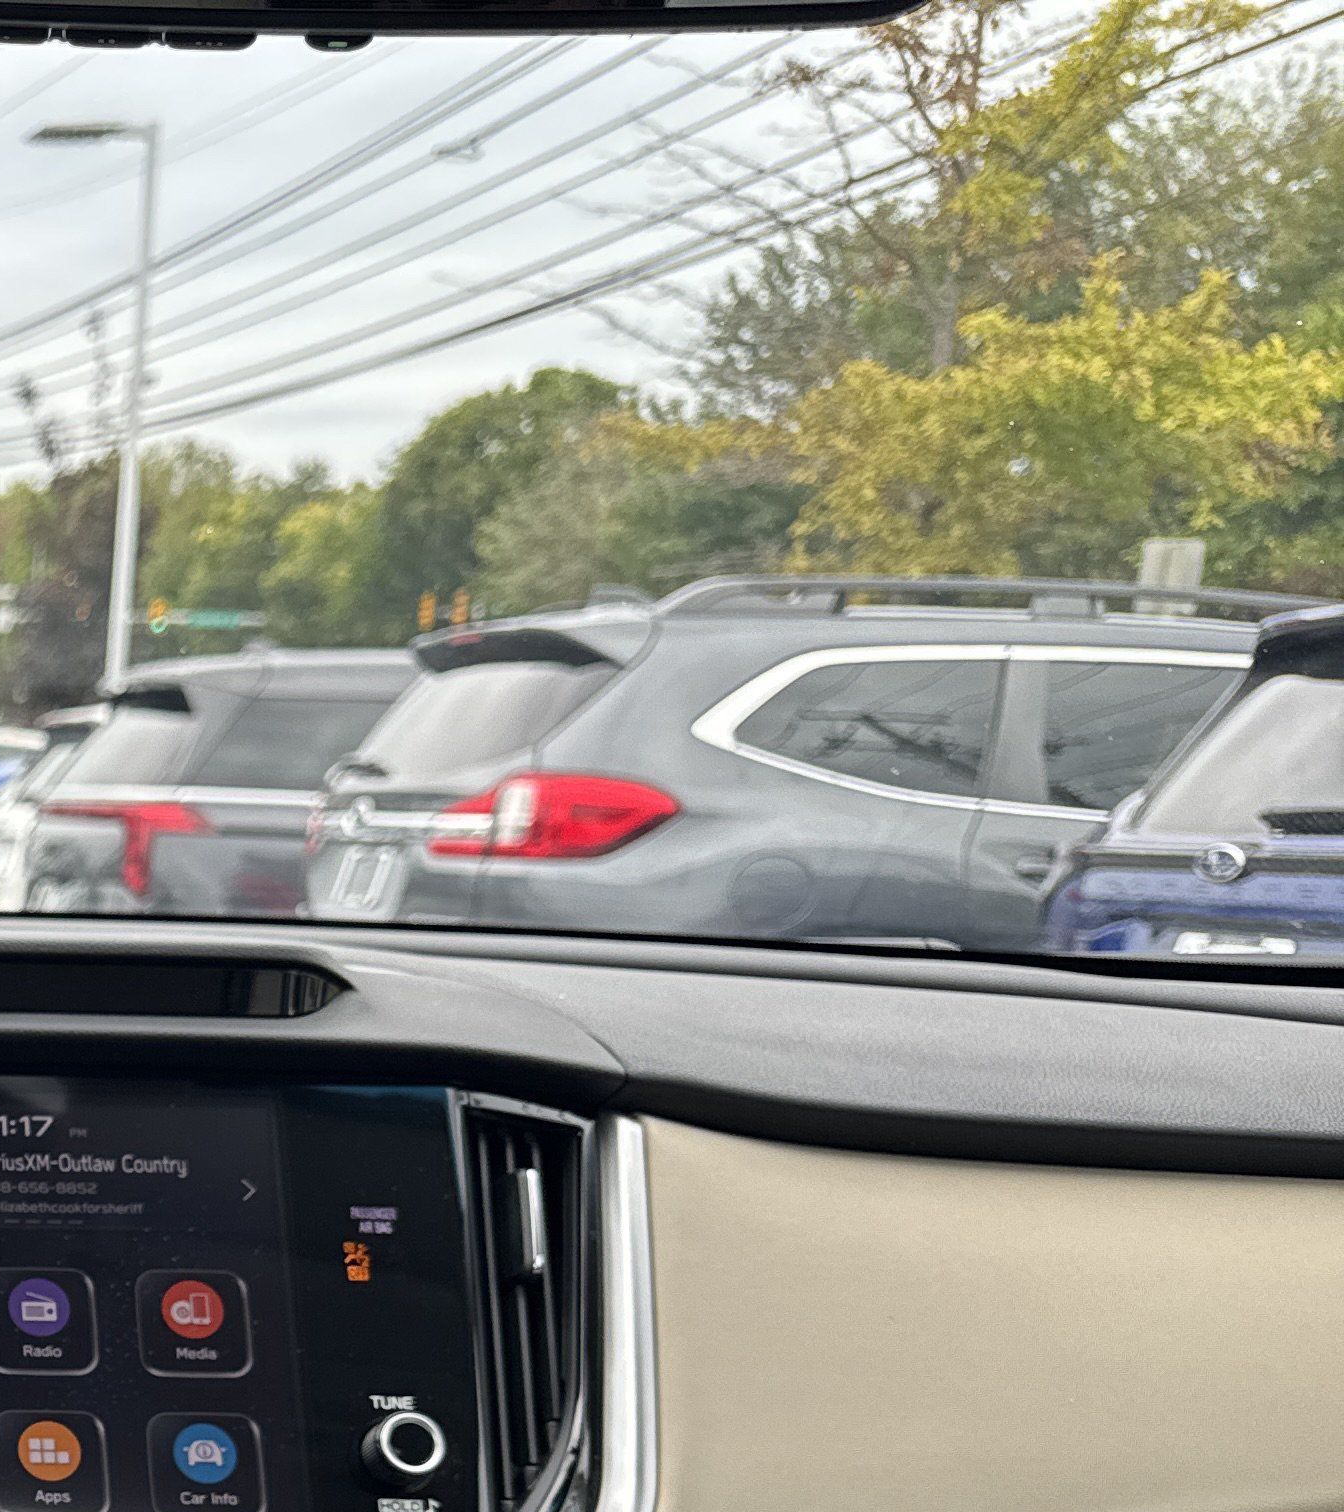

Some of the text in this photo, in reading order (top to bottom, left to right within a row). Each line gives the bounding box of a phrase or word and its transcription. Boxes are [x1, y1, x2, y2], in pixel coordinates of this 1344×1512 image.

[121, 1155, 188, 1178] Country
[23, 1345, 62, 1359] Radio
[176, 1347, 218, 1361] Media
[368, 1395, 416, 1410] TUNE
[35, 1490, 71, 1505] Apps
[180, 1492, 238, 1506] Car Info
[379, 1500, 423, 1512] HOLD
